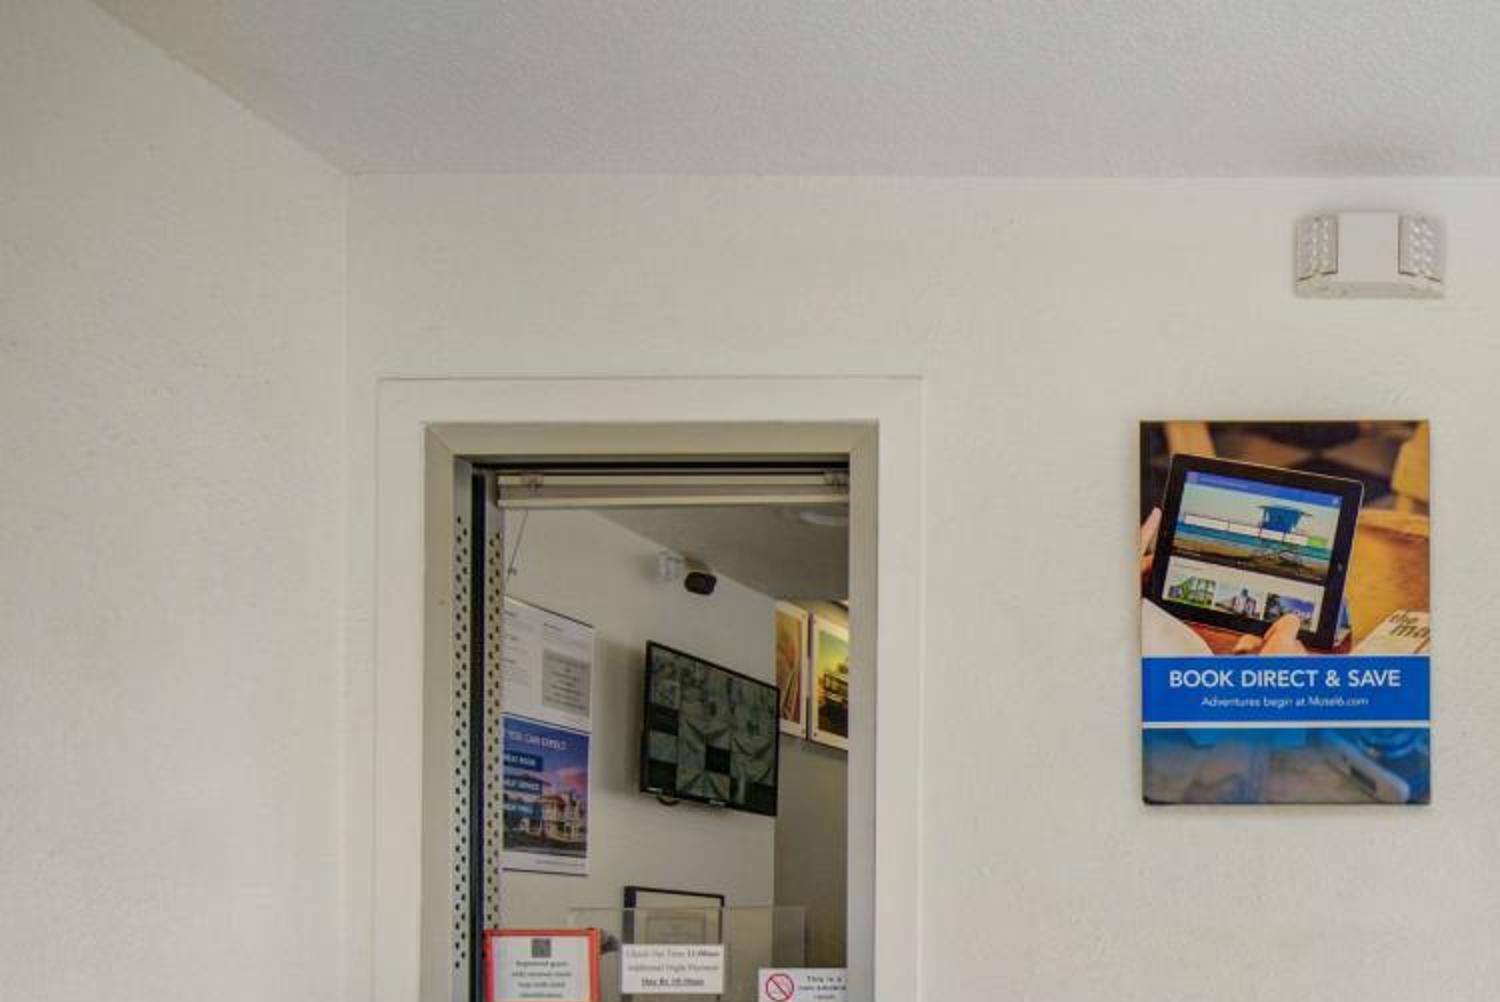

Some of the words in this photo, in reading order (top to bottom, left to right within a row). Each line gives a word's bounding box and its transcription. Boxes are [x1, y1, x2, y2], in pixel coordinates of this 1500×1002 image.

[1169, 669, 1234, 688] BOOK
[1241, 669, 1319, 688] DIRECT
[1325, 669, 1341, 688] &
[1348, 669, 1401, 688] SAVE
[1200, 696, 1261, 707] Adventures
[1263, 696, 1292, 709] begin
[1295, 697, 1307, 707] at
